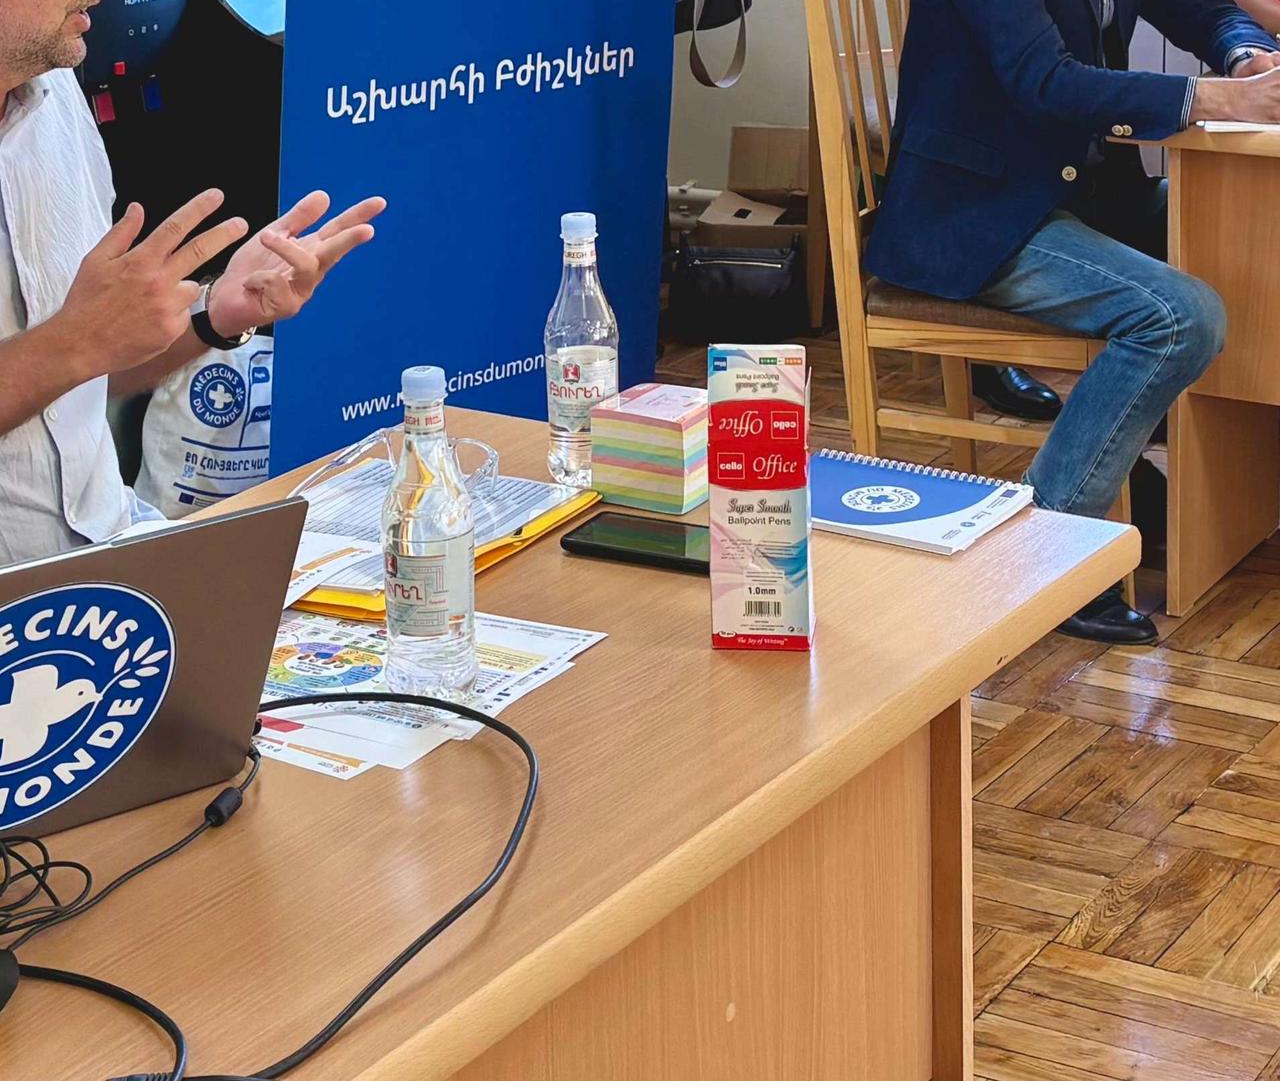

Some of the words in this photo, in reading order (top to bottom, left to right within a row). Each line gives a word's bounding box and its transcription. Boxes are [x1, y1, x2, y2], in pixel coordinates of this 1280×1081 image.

[326, 63, 484, 124] Աշխարհի
[495, 41, 635, 94] Բժիշկներ
[193, 398, 205, 414] DU
[718, 410, 763, 436] Office
[773, 421, 797, 430] cello
[719, 461, 743, 471] cello
[752, 454, 798, 480] Office
[727, 515, 766, 528] Ballpoint
[767, 516, 792, 526] Pens
[747, 586, 777, 596] 1.0mm
